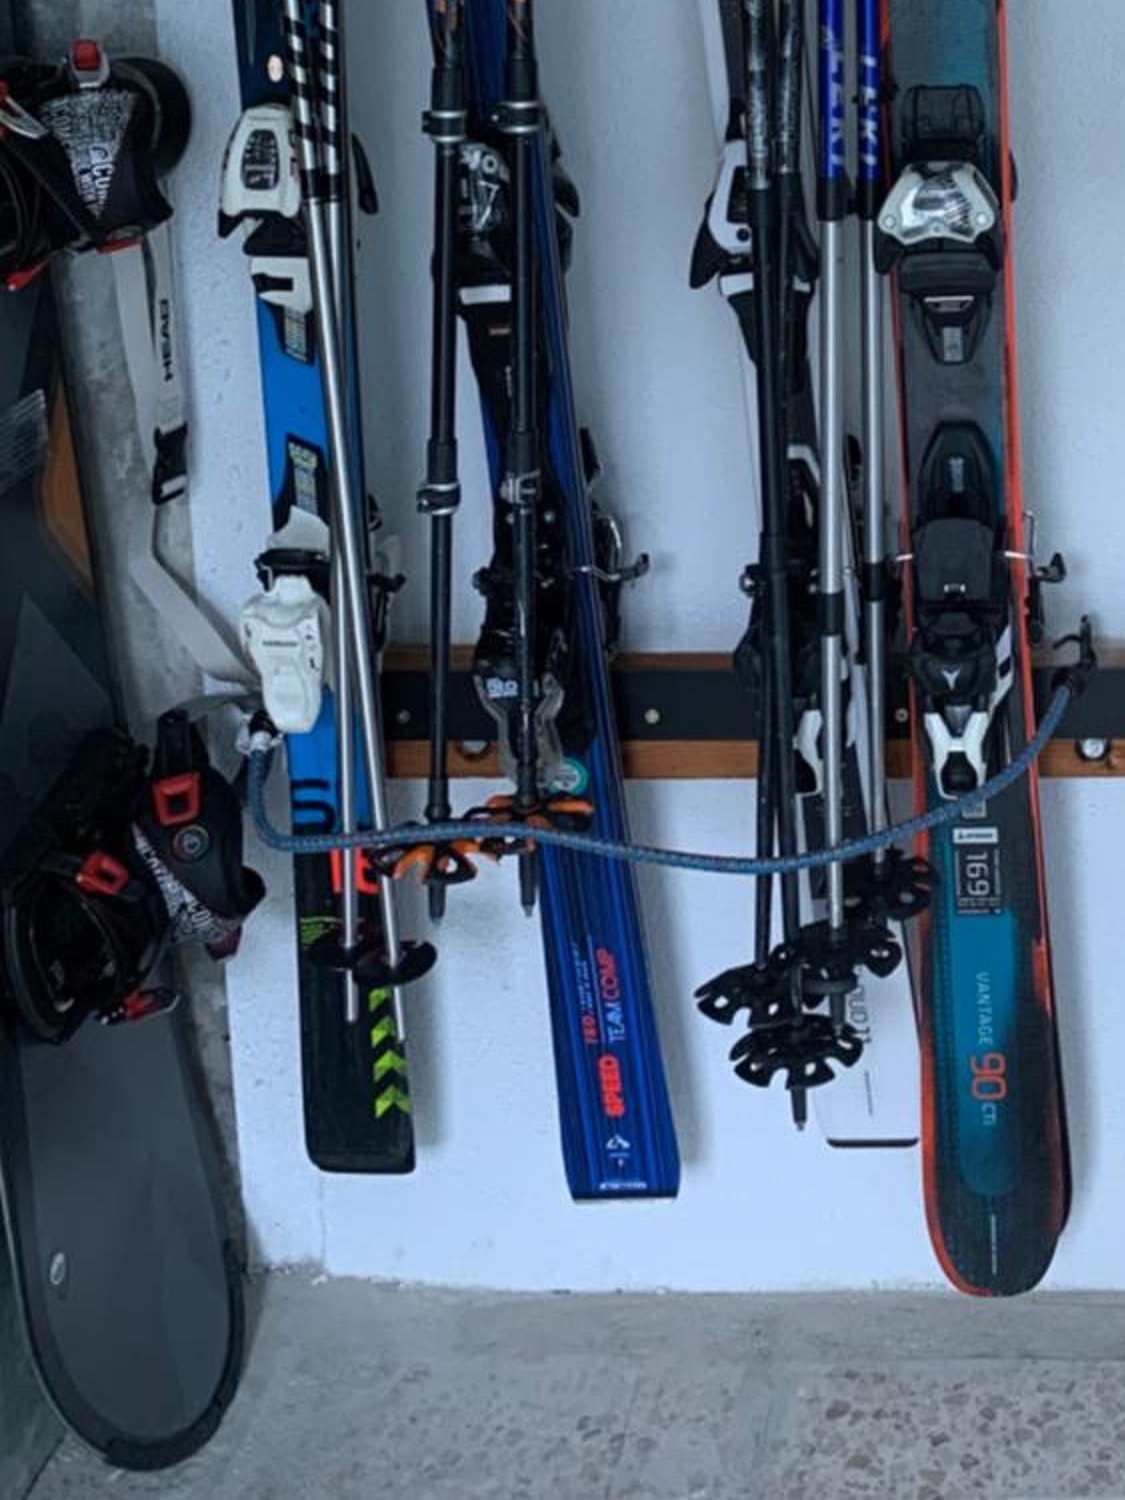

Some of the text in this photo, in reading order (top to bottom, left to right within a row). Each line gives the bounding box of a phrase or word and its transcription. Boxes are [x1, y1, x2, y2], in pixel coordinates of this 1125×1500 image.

[160, 298, 173, 382] HEAD
[966, 851, 989, 896] 169
[604, 1001, 625, 1043] TEAM
[975, 971, 993, 1045] VANTAGE
[597, 1053, 625, 1117] SPEED
[970, 1052, 1007, 1100] 90
